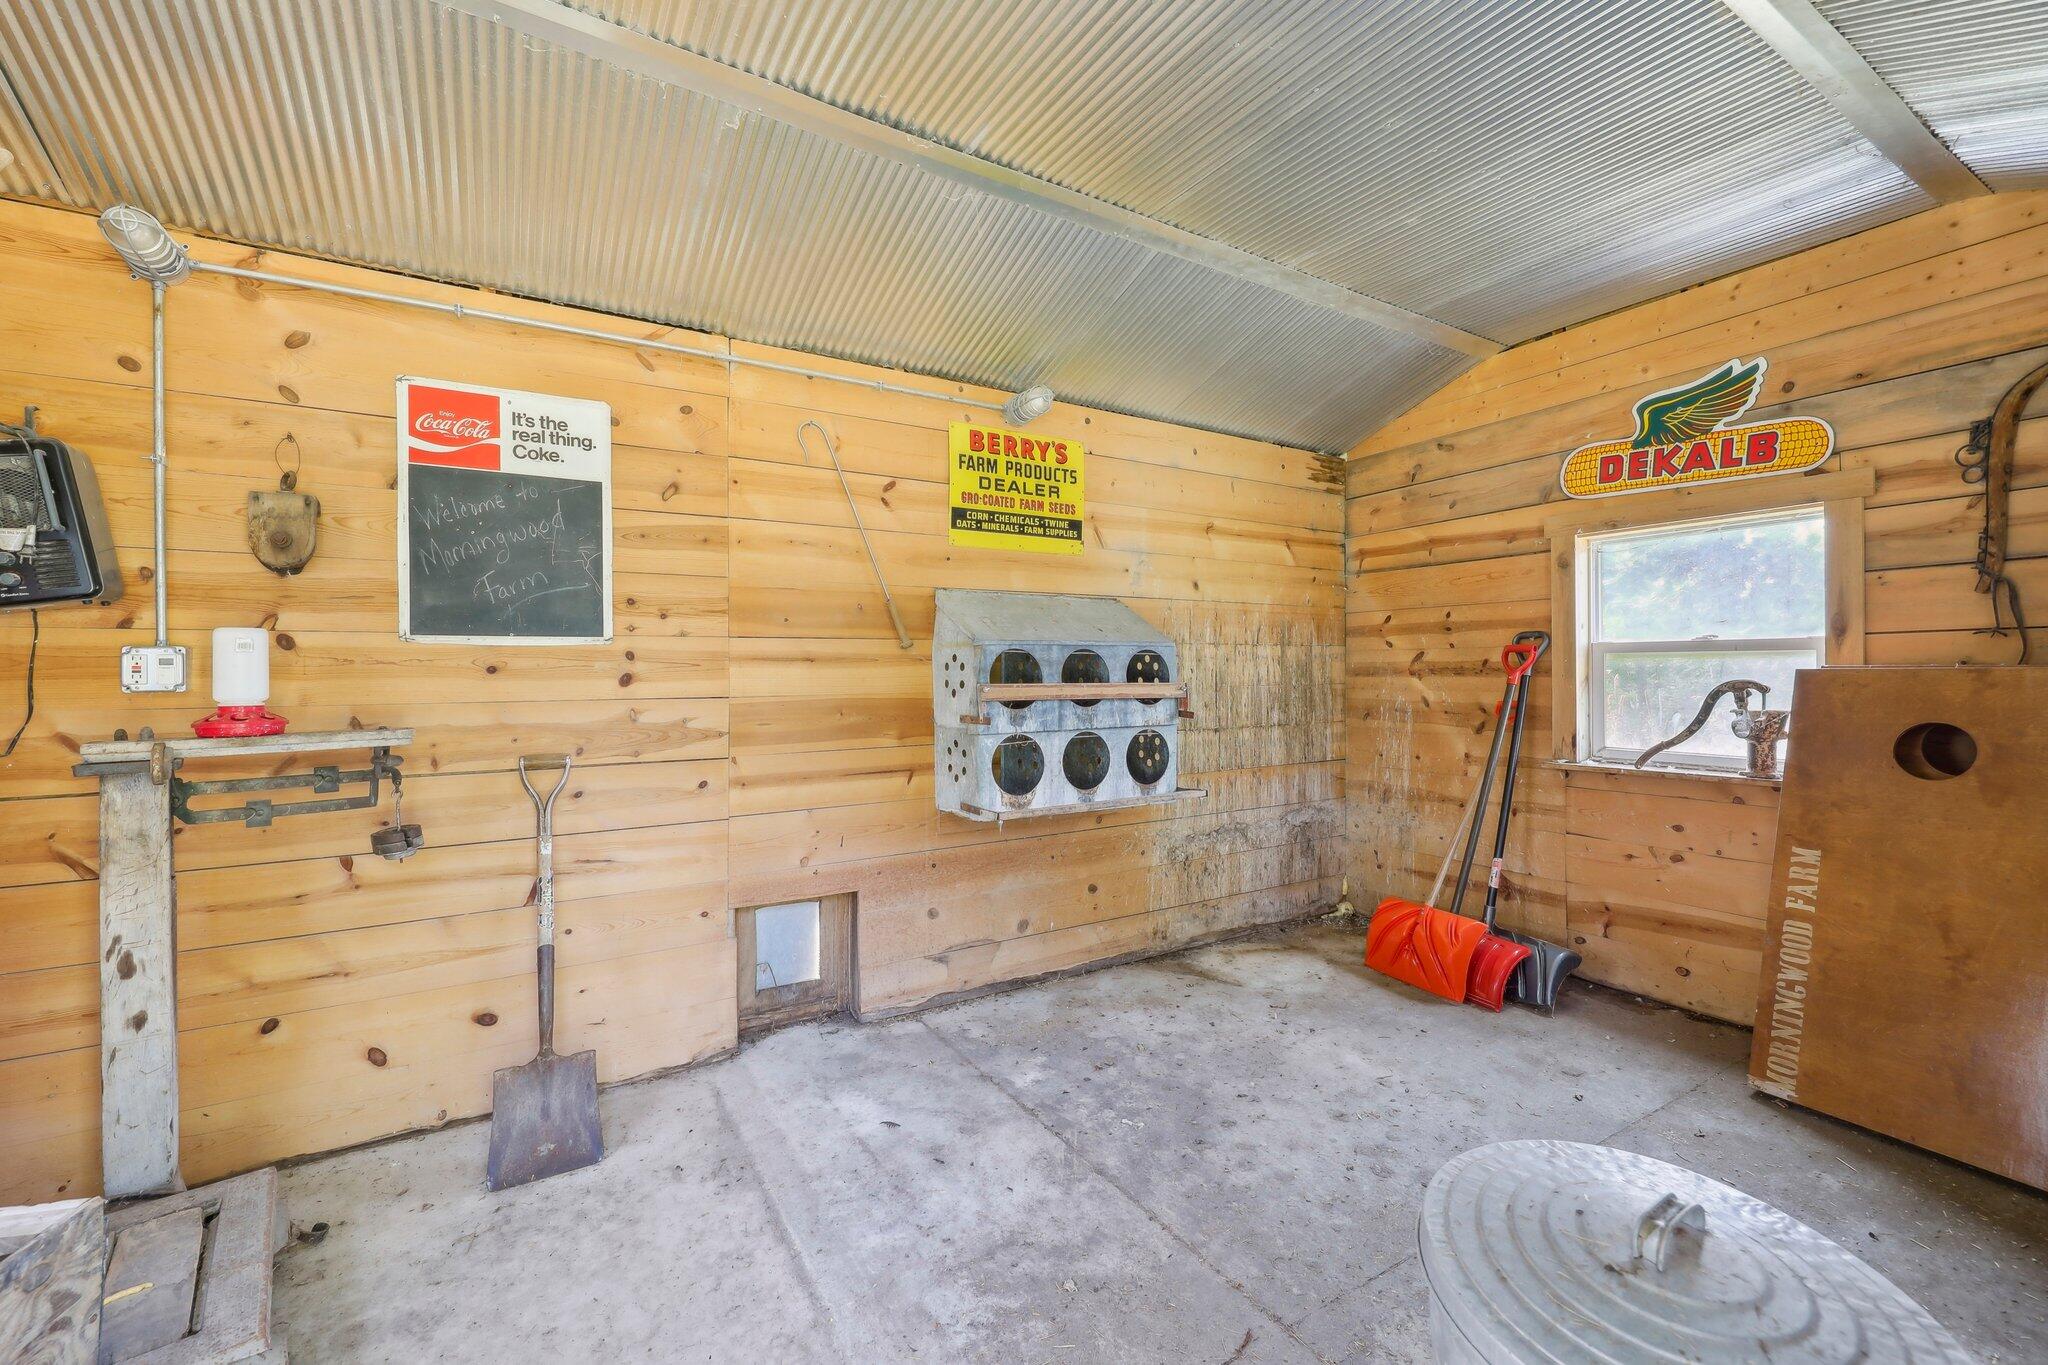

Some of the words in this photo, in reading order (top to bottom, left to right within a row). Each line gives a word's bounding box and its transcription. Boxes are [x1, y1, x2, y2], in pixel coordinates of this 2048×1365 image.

[511, 411, 536, 428] It's
[539, 415, 569, 432] the
[512, 429, 546, 444] real
[548, 431, 597, 451] thing.
[512, 444, 565, 463] Coke.
[969, 429, 1069, 465] BERRY'S
[958, 453, 998, 474] FARM
[1005, 460, 1078, 484] PRODUCTS
[1598, 430, 1780, 485] DEKALB
[978, 476, 1060, 499] DEALER
[413, 495, 506, 531] Welcome
[516, 482, 539, 501] to
[966, 511, 989, 521] CORN
[994, 514, 1040, 526] CHEMICALS
[1045, 519, 1069, 529] TWINE
[1020, 498, 1045, 512] FARM
[1048, 501, 1076, 516] SEEDS
[420, 499, 565, 575] Morningwood
[956, 519, 976, 529] OATS
[981, 521, 1019, 533] MINERALS
[1024, 526, 1044, 535] FARM
[1045, 528, 1078, 538] SUPPLIES
[477, 570, 550, 604] Farm
[1785, 846, 1822, 914] FARM
[1766, 919, 1814, 1098] MORNINGWOOD
